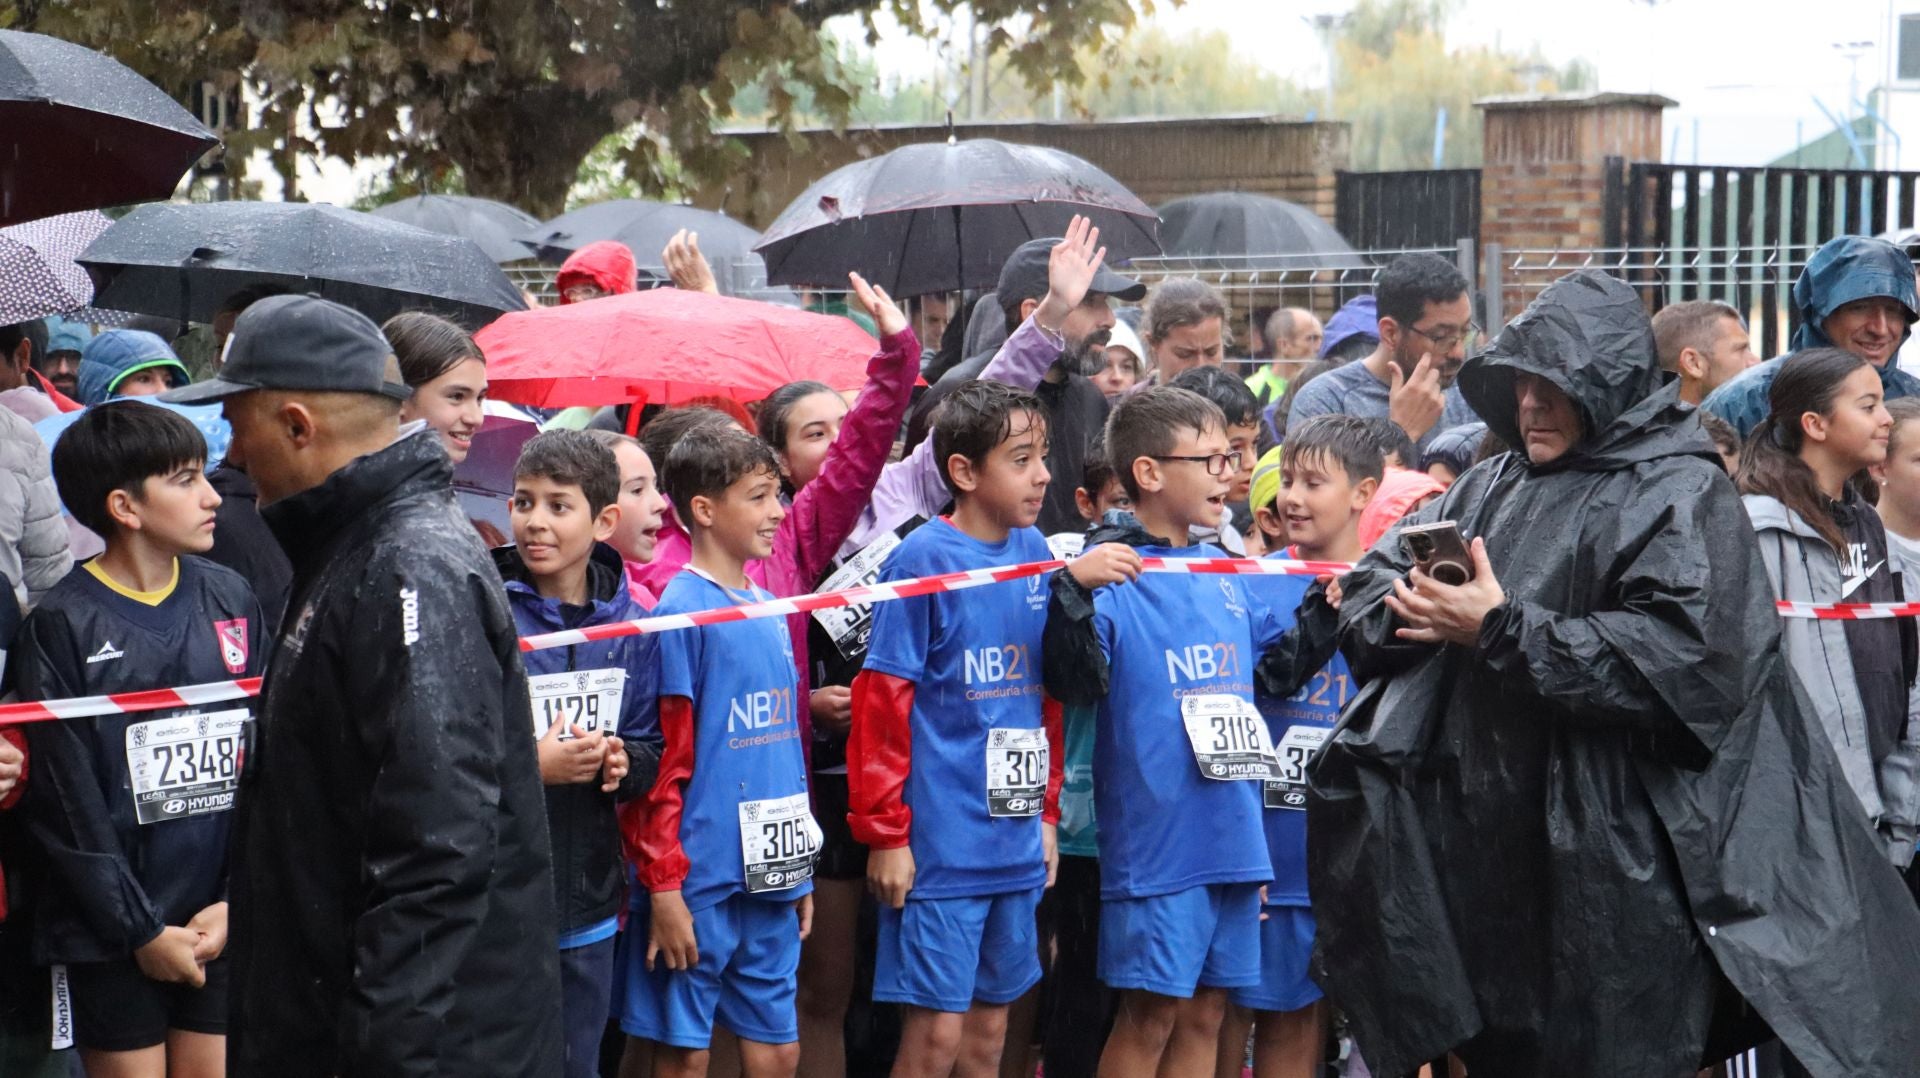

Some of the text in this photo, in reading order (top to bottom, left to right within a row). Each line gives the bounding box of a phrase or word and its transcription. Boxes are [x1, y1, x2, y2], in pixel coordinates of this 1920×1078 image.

[400, 588, 419, 646] Joma
[965, 644, 1030, 684] NB21
[1165, 643, 1239, 684] NB21
[728, 687, 791, 733] NB21
[1211, 716, 1260, 751] 3118
[152, 737, 235, 787] 2348
